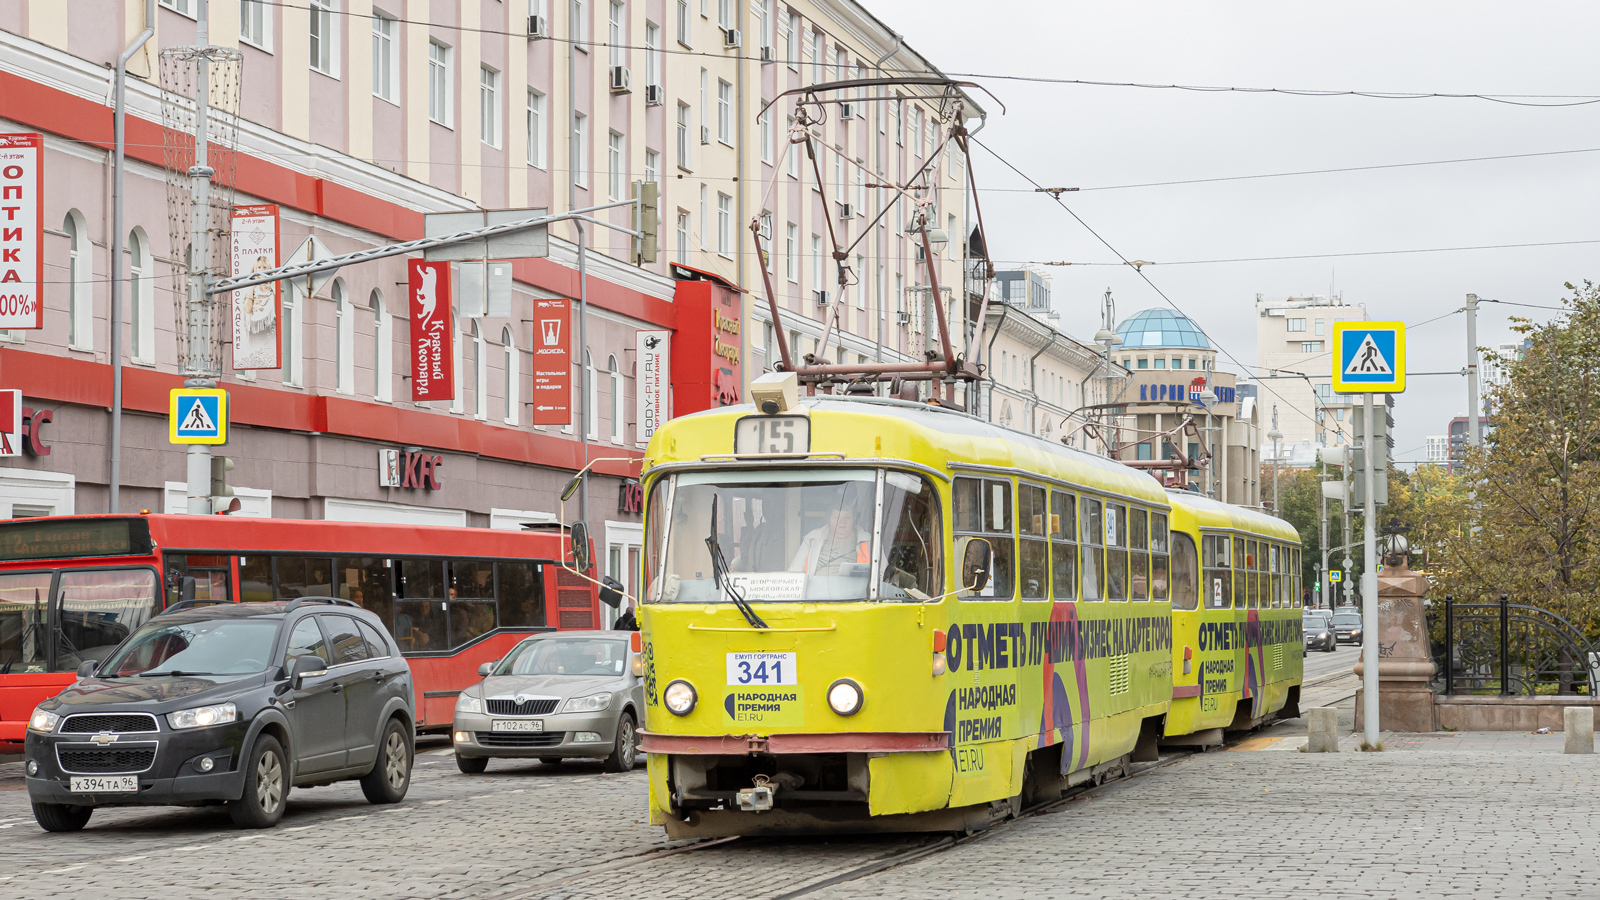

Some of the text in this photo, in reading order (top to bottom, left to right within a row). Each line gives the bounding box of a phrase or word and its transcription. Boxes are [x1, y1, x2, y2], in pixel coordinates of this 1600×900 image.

[2, 165, 23, 283] ОПТИКА
[233, 231, 241, 349] ПАВЛОВОСАДСКИЕ
[424, 320, 444, 380] Красный
[416, 338, 431, 395] Леопард
[645, 353, 653, 438] BODY-PIT.RU
[1140, 384, 1184, 400] КОРИН
[753, 420, 794, 453] 15
[403, 452, 443, 490] KFC
[624, 483, 643, 512] KF
[1215, 582, 1221, 597] 2
[946, 623, 1026, 673] ОТМЕТЬ
[1029, 610, 1075, 666] ЛУЧШИЙ
[1078, 619, 1112, 660] БИЗНЕС
[1112, 618, 1124, 656] НА
[1126, 616, 1151, 654] КАРТЕ
[1199, 622, 1238, 652] ОТМЕТЬ
[738, 661, 782, 684] 341
[1205, 660, 1234, 675] НАРОДНАЯ
[738, 693, 796, 702] НАРОДНАЯ
[959, 684, 1016, 711] НАРОДНАЯ
[1205, 679, 1227, 693] ПРЕМИЯ
[738, 713, 763, 721] E1.RU
[959, 716, 1001, 743] ПРЕМИЯ
[959, 749, 984, 772] E1.RU
[123, 778, 134, 786] 96
